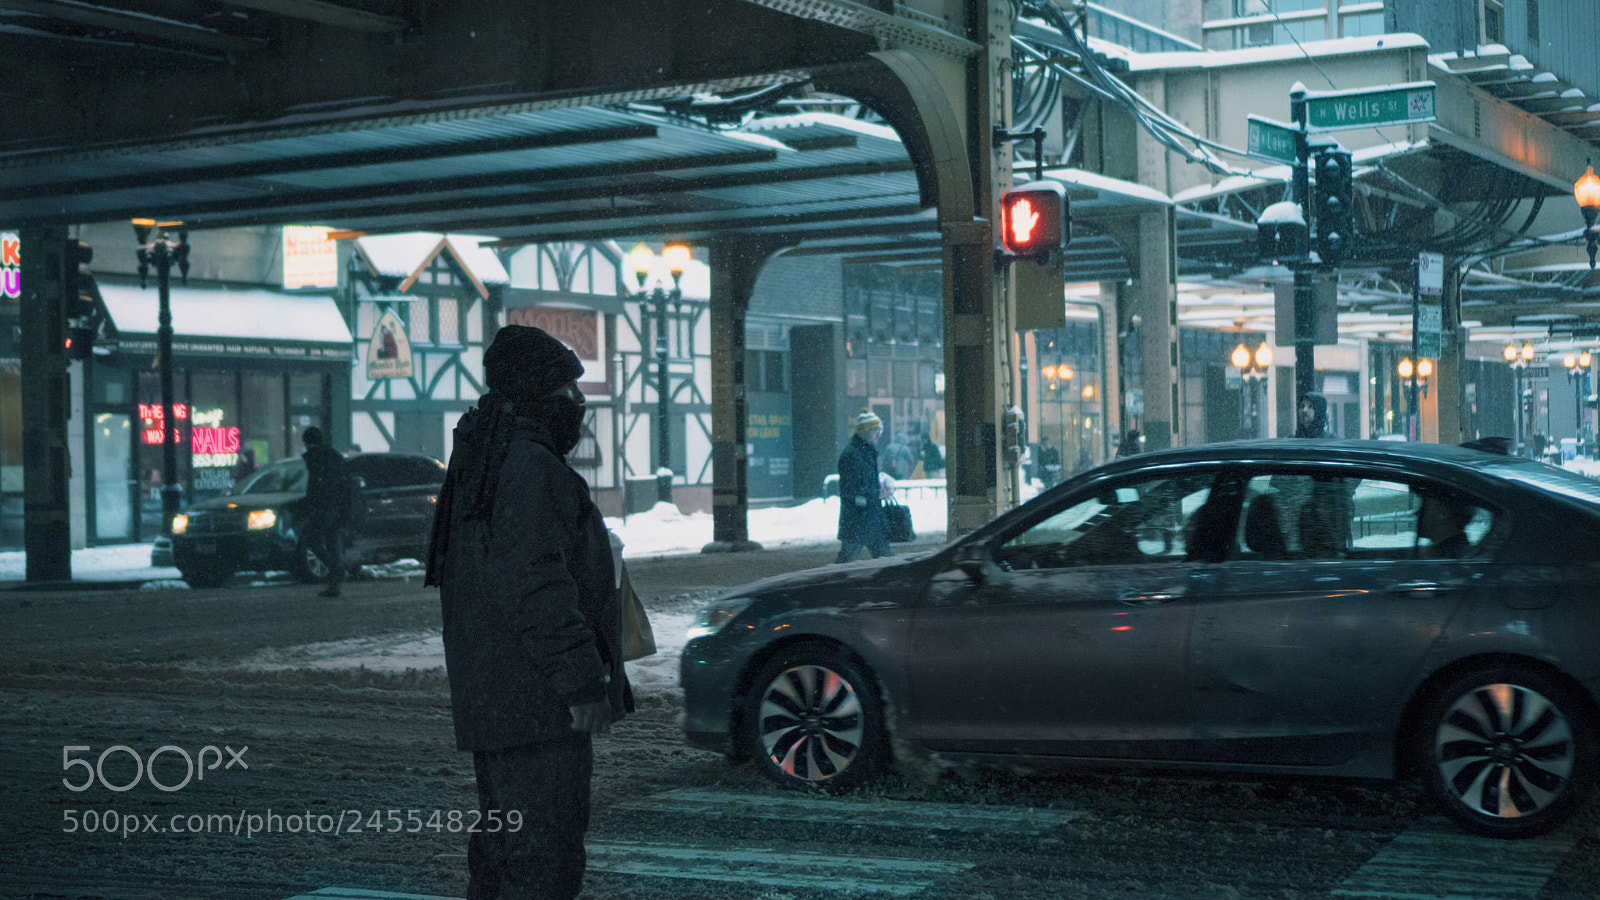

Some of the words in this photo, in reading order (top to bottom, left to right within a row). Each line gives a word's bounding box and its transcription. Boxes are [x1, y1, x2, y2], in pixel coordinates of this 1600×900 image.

[1334, 100, 1380, 121] Wells
[1388, 100, 1398, 111] St
[1267, 131, 1287, 153] Lake
[192, 426, 240, 454] NAILS
